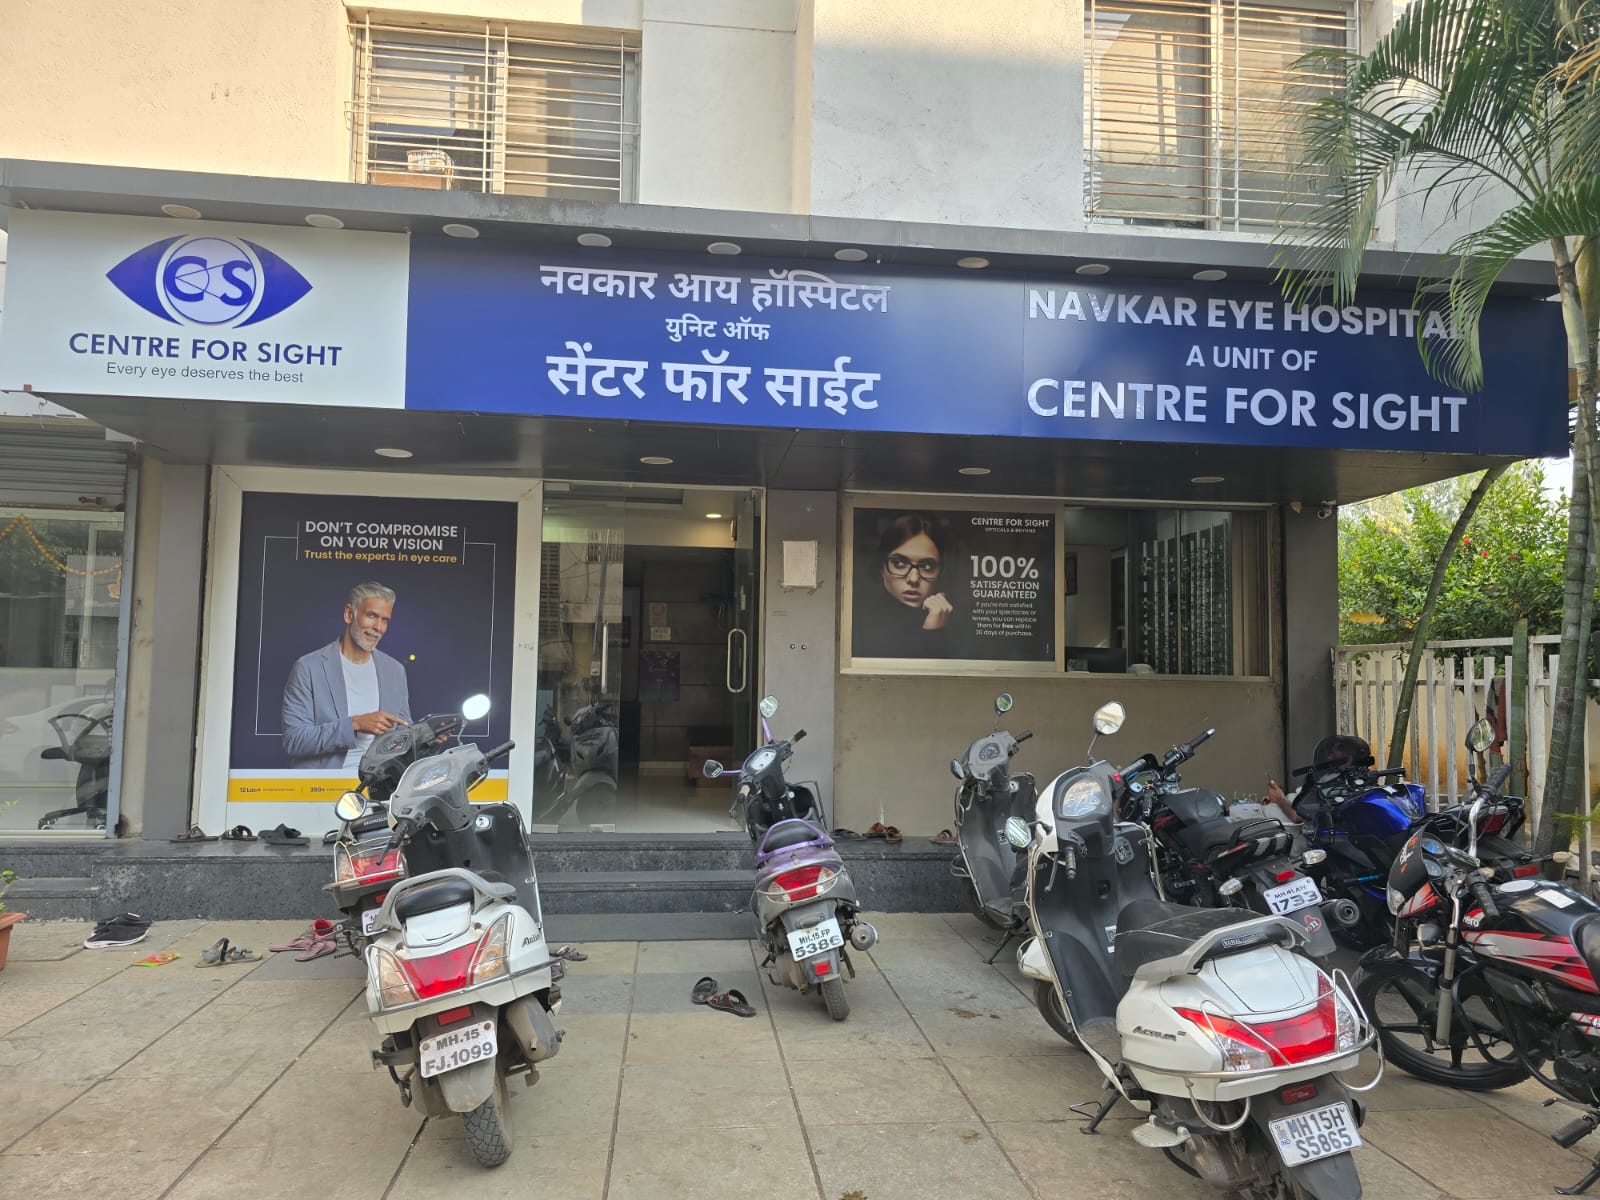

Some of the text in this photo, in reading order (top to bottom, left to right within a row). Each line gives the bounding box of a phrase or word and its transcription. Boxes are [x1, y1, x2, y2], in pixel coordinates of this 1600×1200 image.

[540, 265, 892, 312] नवकार आय हॉस्पिटल
[1029, 289, 1197, 327] NAVKAR
[1206, 299, 1274, 331] EYE
[665, 313, 770, 342] युनिट ऑफ
[69, 332, 343, 367] CENTRE FOR SIGHT
[1186, 345, 1318, 372] A UNIT OF
[107, 362, 303, 383] Every eye deserves the best
[545, 341, 881, 416] सेंटर फॉर साईट
[1026, 378, 1468, 433] CENTRE FOR SIGHT
[305, 521, 458, 538] DON'T COMPROMISE
[971, 517, 1050, 528] CENTRE FOR SIGHT
[320, 535, 444, 551] ON YOUR VISION
[304, 550, 457, 565] Trust the experts in eye care
[970, 555, 1039, 579] 100%
[970, 580, 1040, 591] SATISFACTION
[972, 589, 1037, 600] GUARANTEED
[1272, 890, 1318, 912] 1733
[795, 935, 842, 958] 5386
[436, 1028, 480, 1051] MH.15
[425, 1041, 494, 1076] FJ.1099
[1286, 1107, 1345, 1139] MH15H
[1296, 1128, 1352, 1159] S5865
